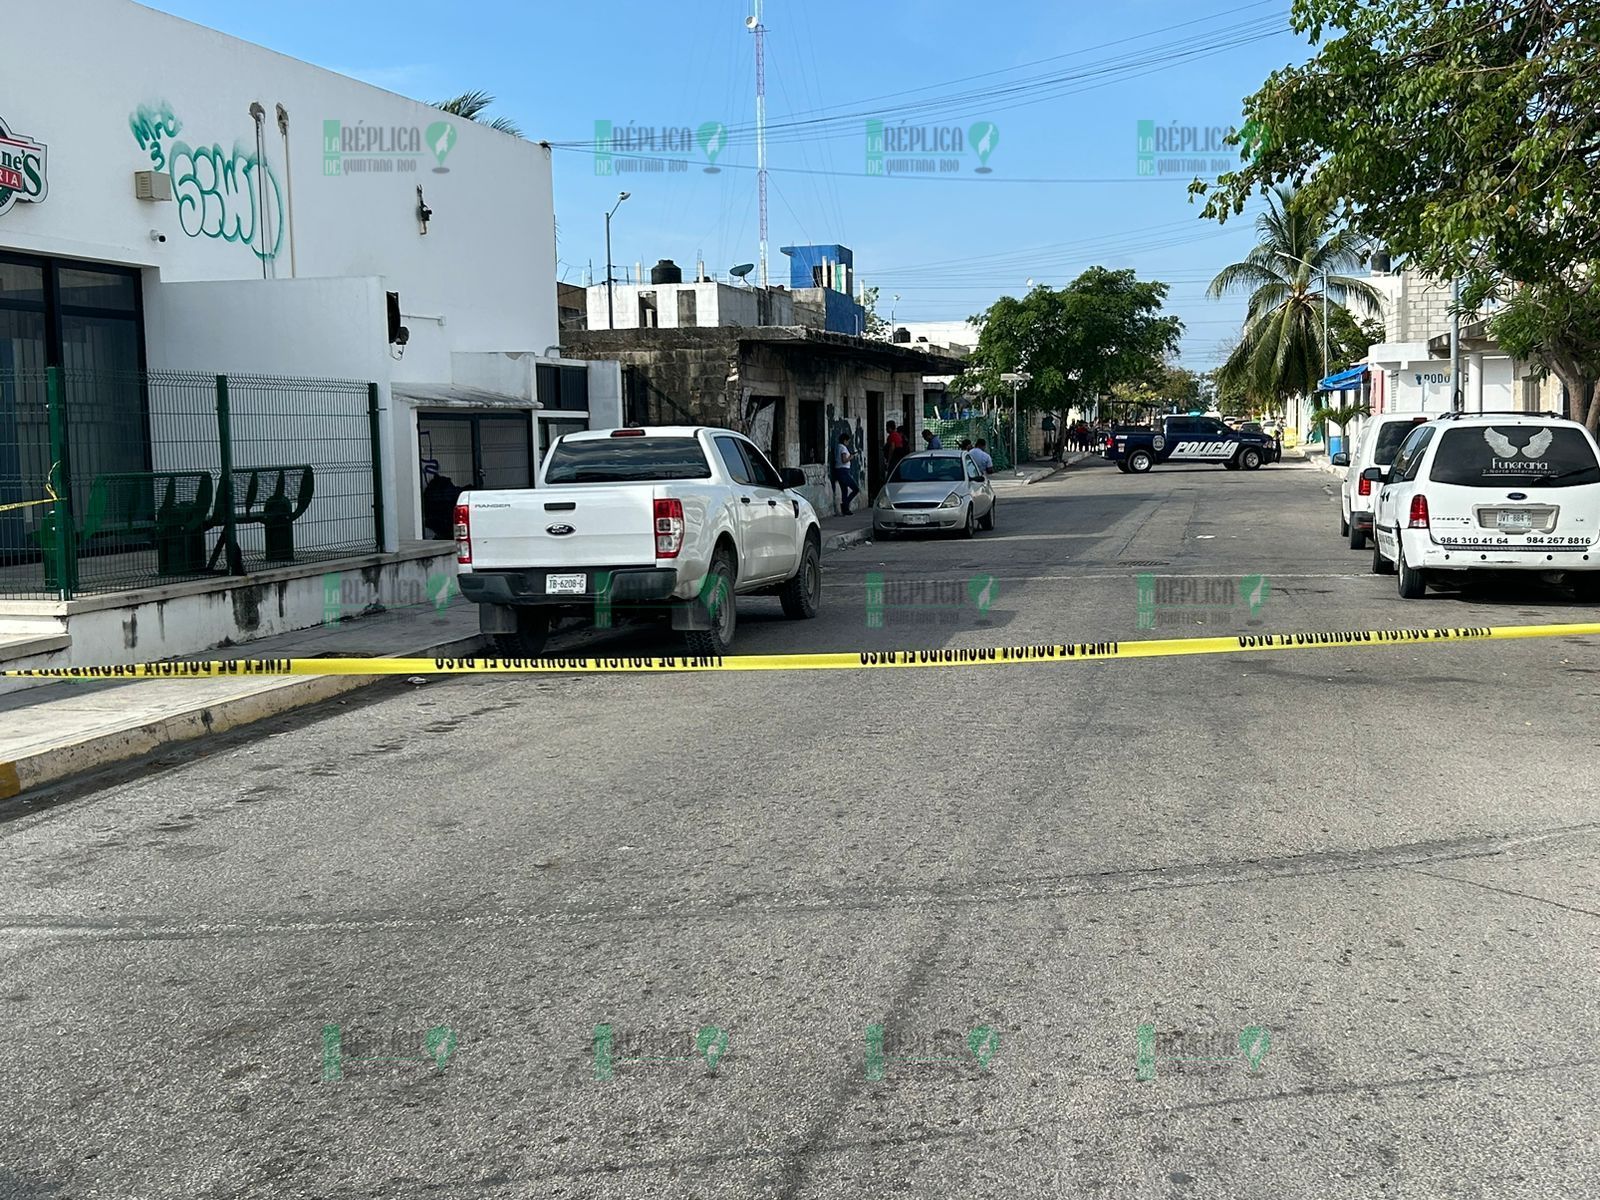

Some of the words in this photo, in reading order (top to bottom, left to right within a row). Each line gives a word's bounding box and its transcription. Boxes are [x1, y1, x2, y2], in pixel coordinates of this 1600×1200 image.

[1492, 457, 1548, 470] Funeraria
[1526, 536, 1544, 544] 984
[1547, 536, 1565, 544] 267
[1567, 536, 1591, 544] 8816
